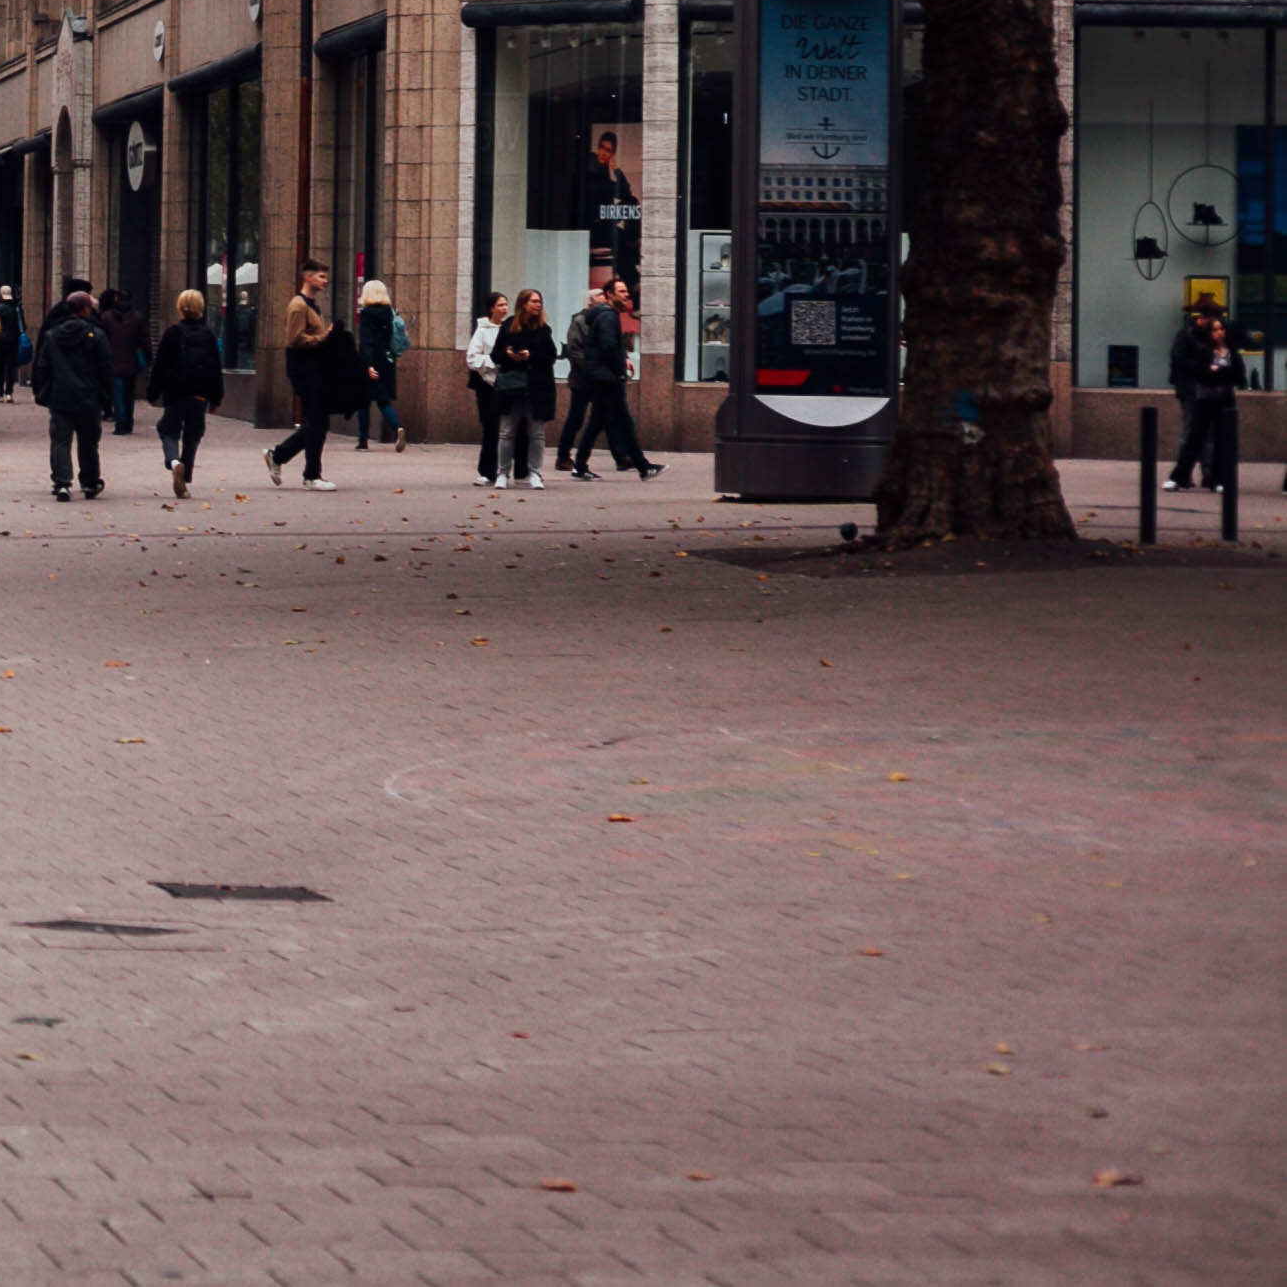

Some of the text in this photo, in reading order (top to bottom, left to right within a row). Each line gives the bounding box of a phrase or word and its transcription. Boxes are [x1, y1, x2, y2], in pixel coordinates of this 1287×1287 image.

[781, 15, 872, 31] DIE GANZE
[795, 33, 866, 60] Welt
[784, 64, 867, 81] IN DEINER
